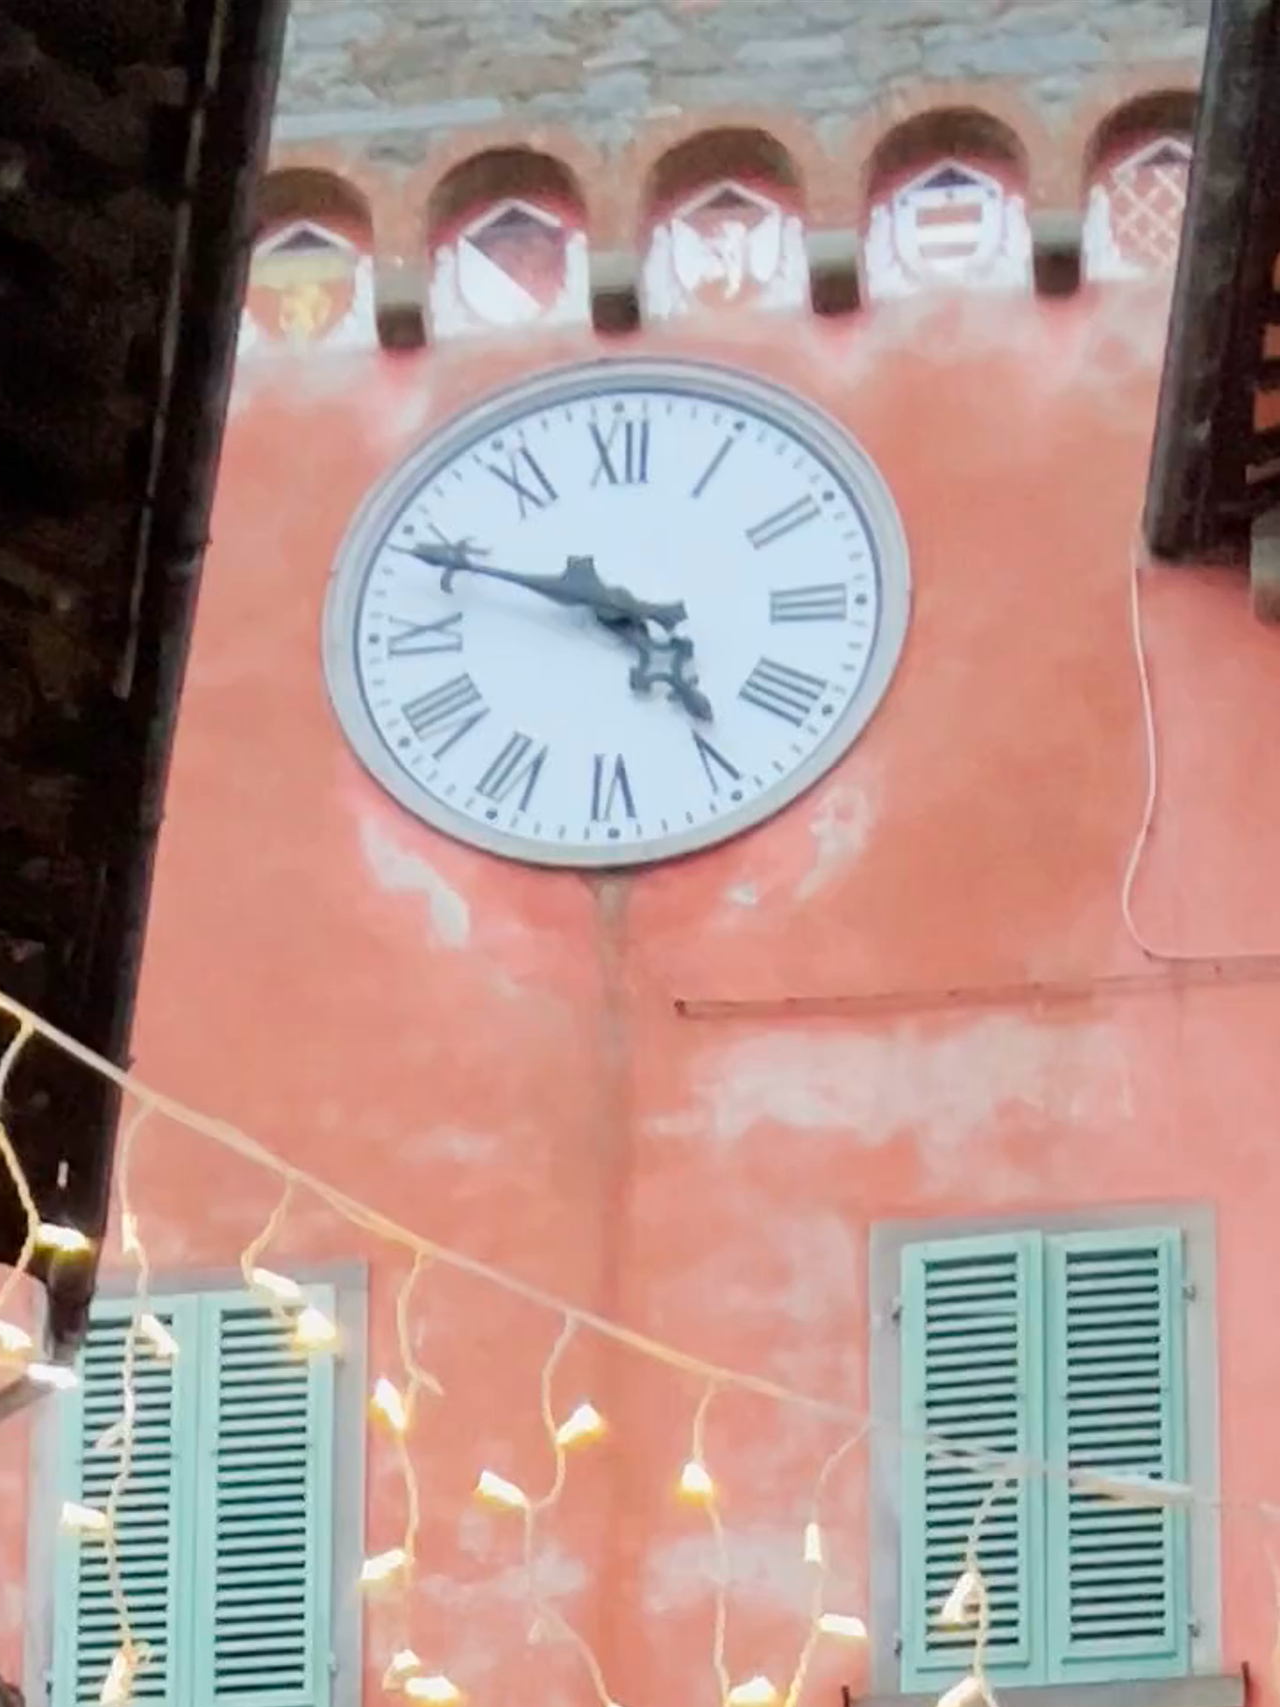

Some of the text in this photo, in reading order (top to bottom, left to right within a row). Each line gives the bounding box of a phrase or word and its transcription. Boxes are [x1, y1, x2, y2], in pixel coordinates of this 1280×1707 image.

[487, 445, 560, 520] XI
[588, 418, 650, 489] XII
[744, 493, 822, 550] II
[387, 611, 464, 658] IX
[769, 582, 848, 625] III
[400, 672, 492, 762] VIII
[737, 657, 829, 728] IIII
[475, 730, 551, 815] VII
[589, 752, 637, 823] VI
[692, 729, 742, 797] V
